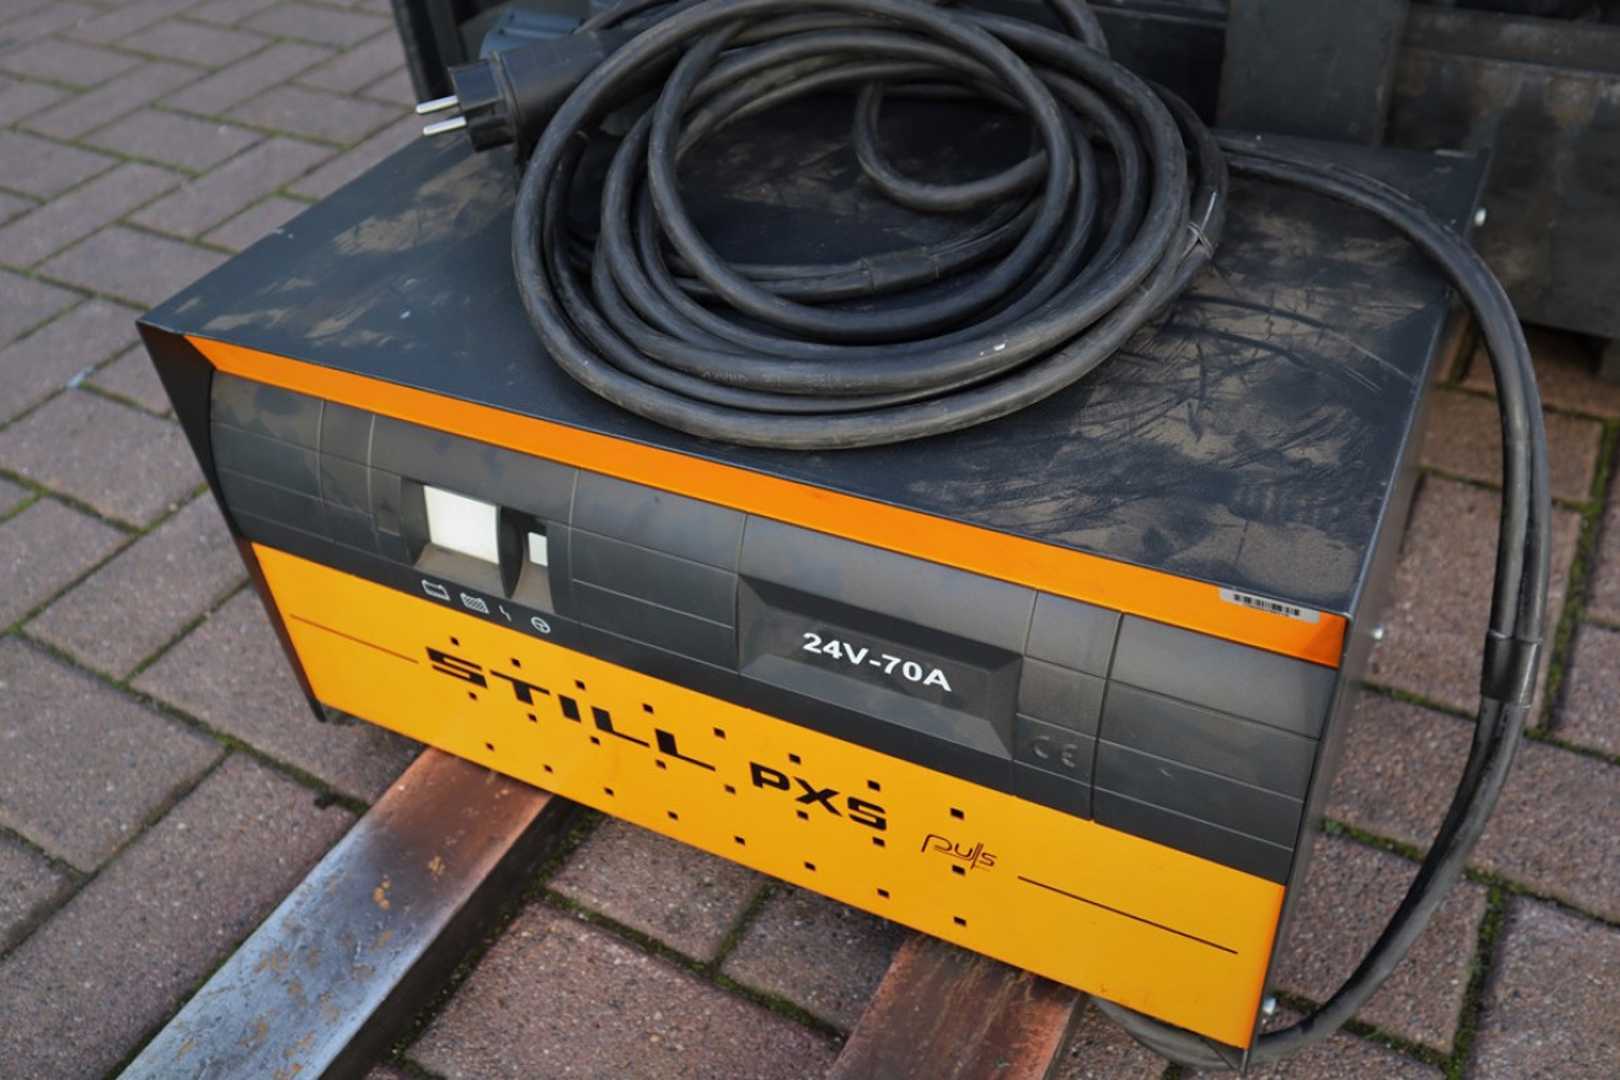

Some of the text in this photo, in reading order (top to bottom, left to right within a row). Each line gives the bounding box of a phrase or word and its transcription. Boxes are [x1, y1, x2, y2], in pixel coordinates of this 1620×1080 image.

[803, 632, 952, 692] 24V-70A
[426, 647, 716, 772] STILL
[750, 761, 887, 831] PXS
[1031, 735, 1079, 769] CE
